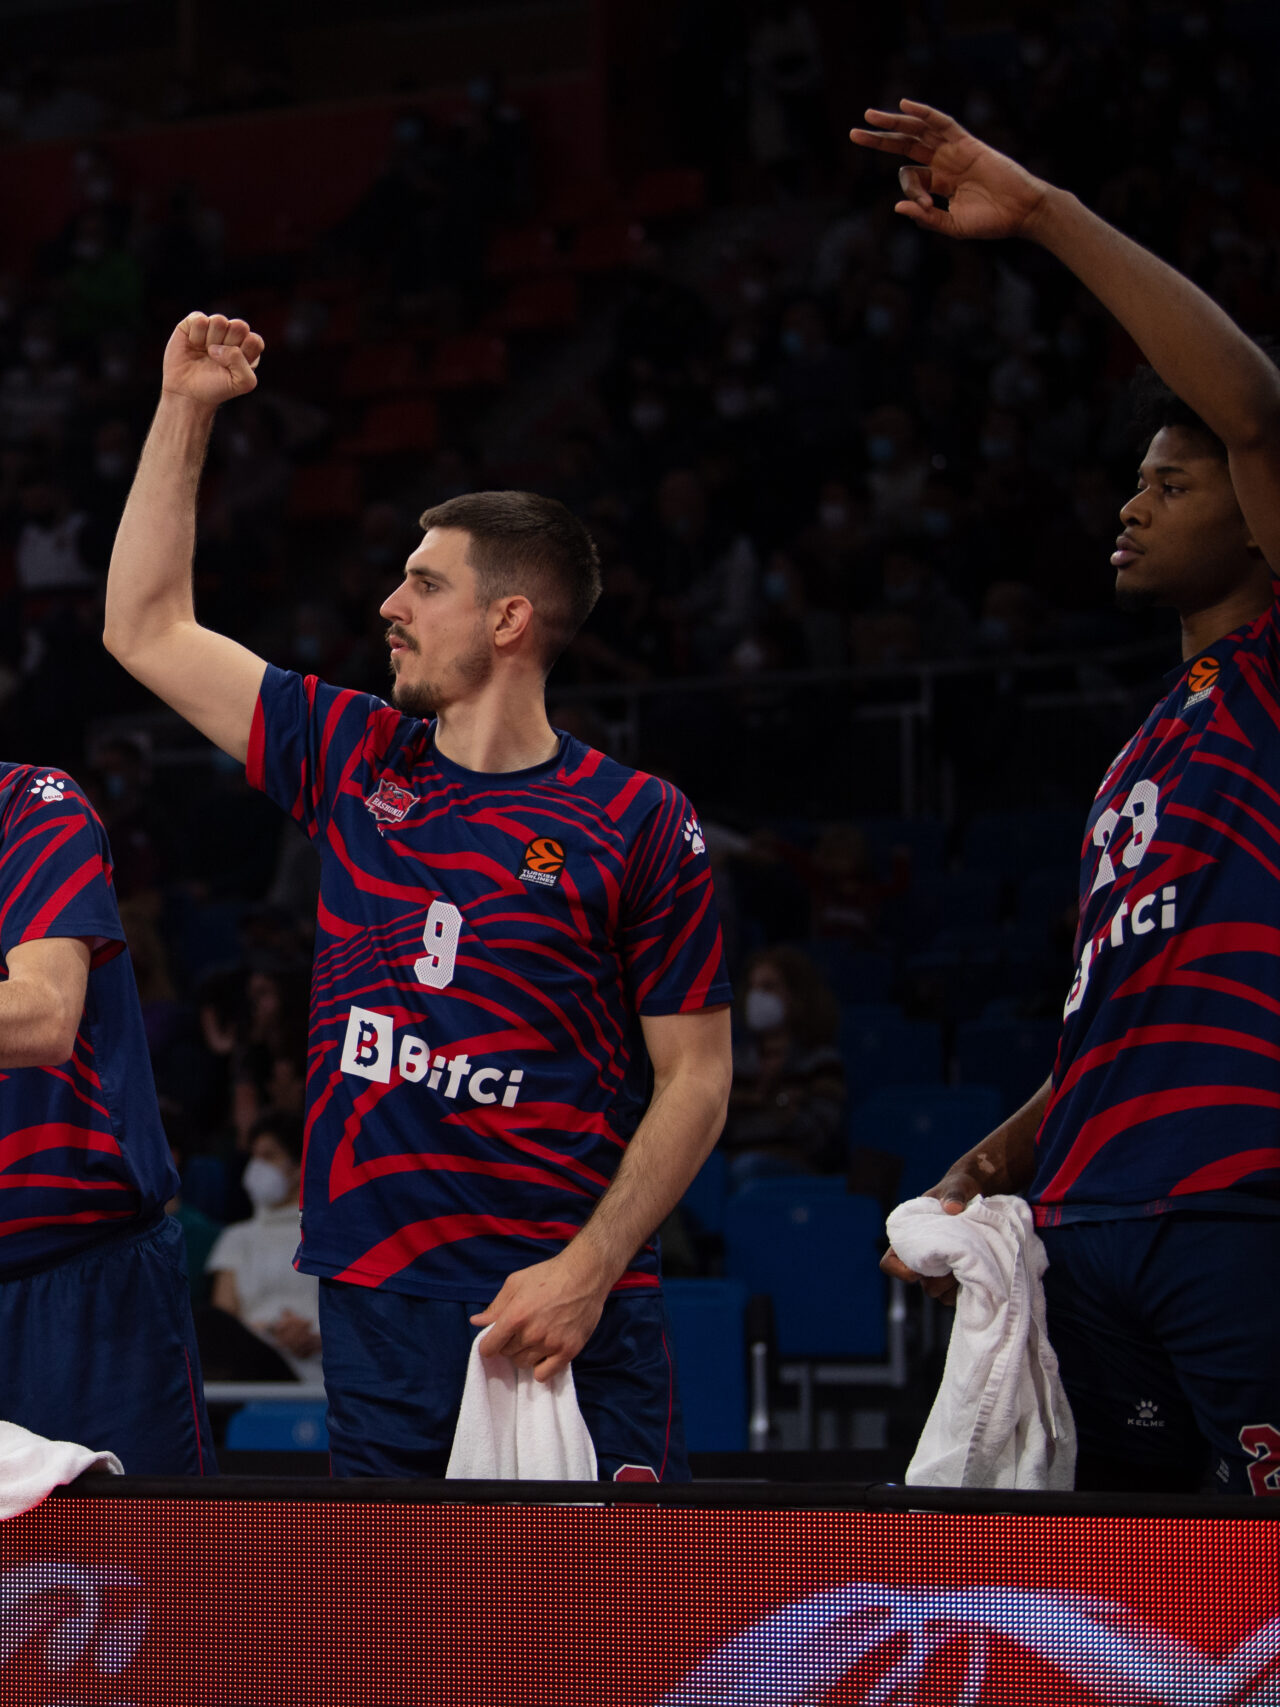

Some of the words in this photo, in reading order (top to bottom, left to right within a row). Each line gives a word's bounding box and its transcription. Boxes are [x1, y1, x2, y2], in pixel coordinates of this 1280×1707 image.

[1091, 778, 1159, 896] 23
[522, 869, 557, 881] TURKISH
[414, 900, 463, 989] 9
[399, 1034, 524, 1108] Bitci
[1127, 1418, 1166, 1428] KELME
